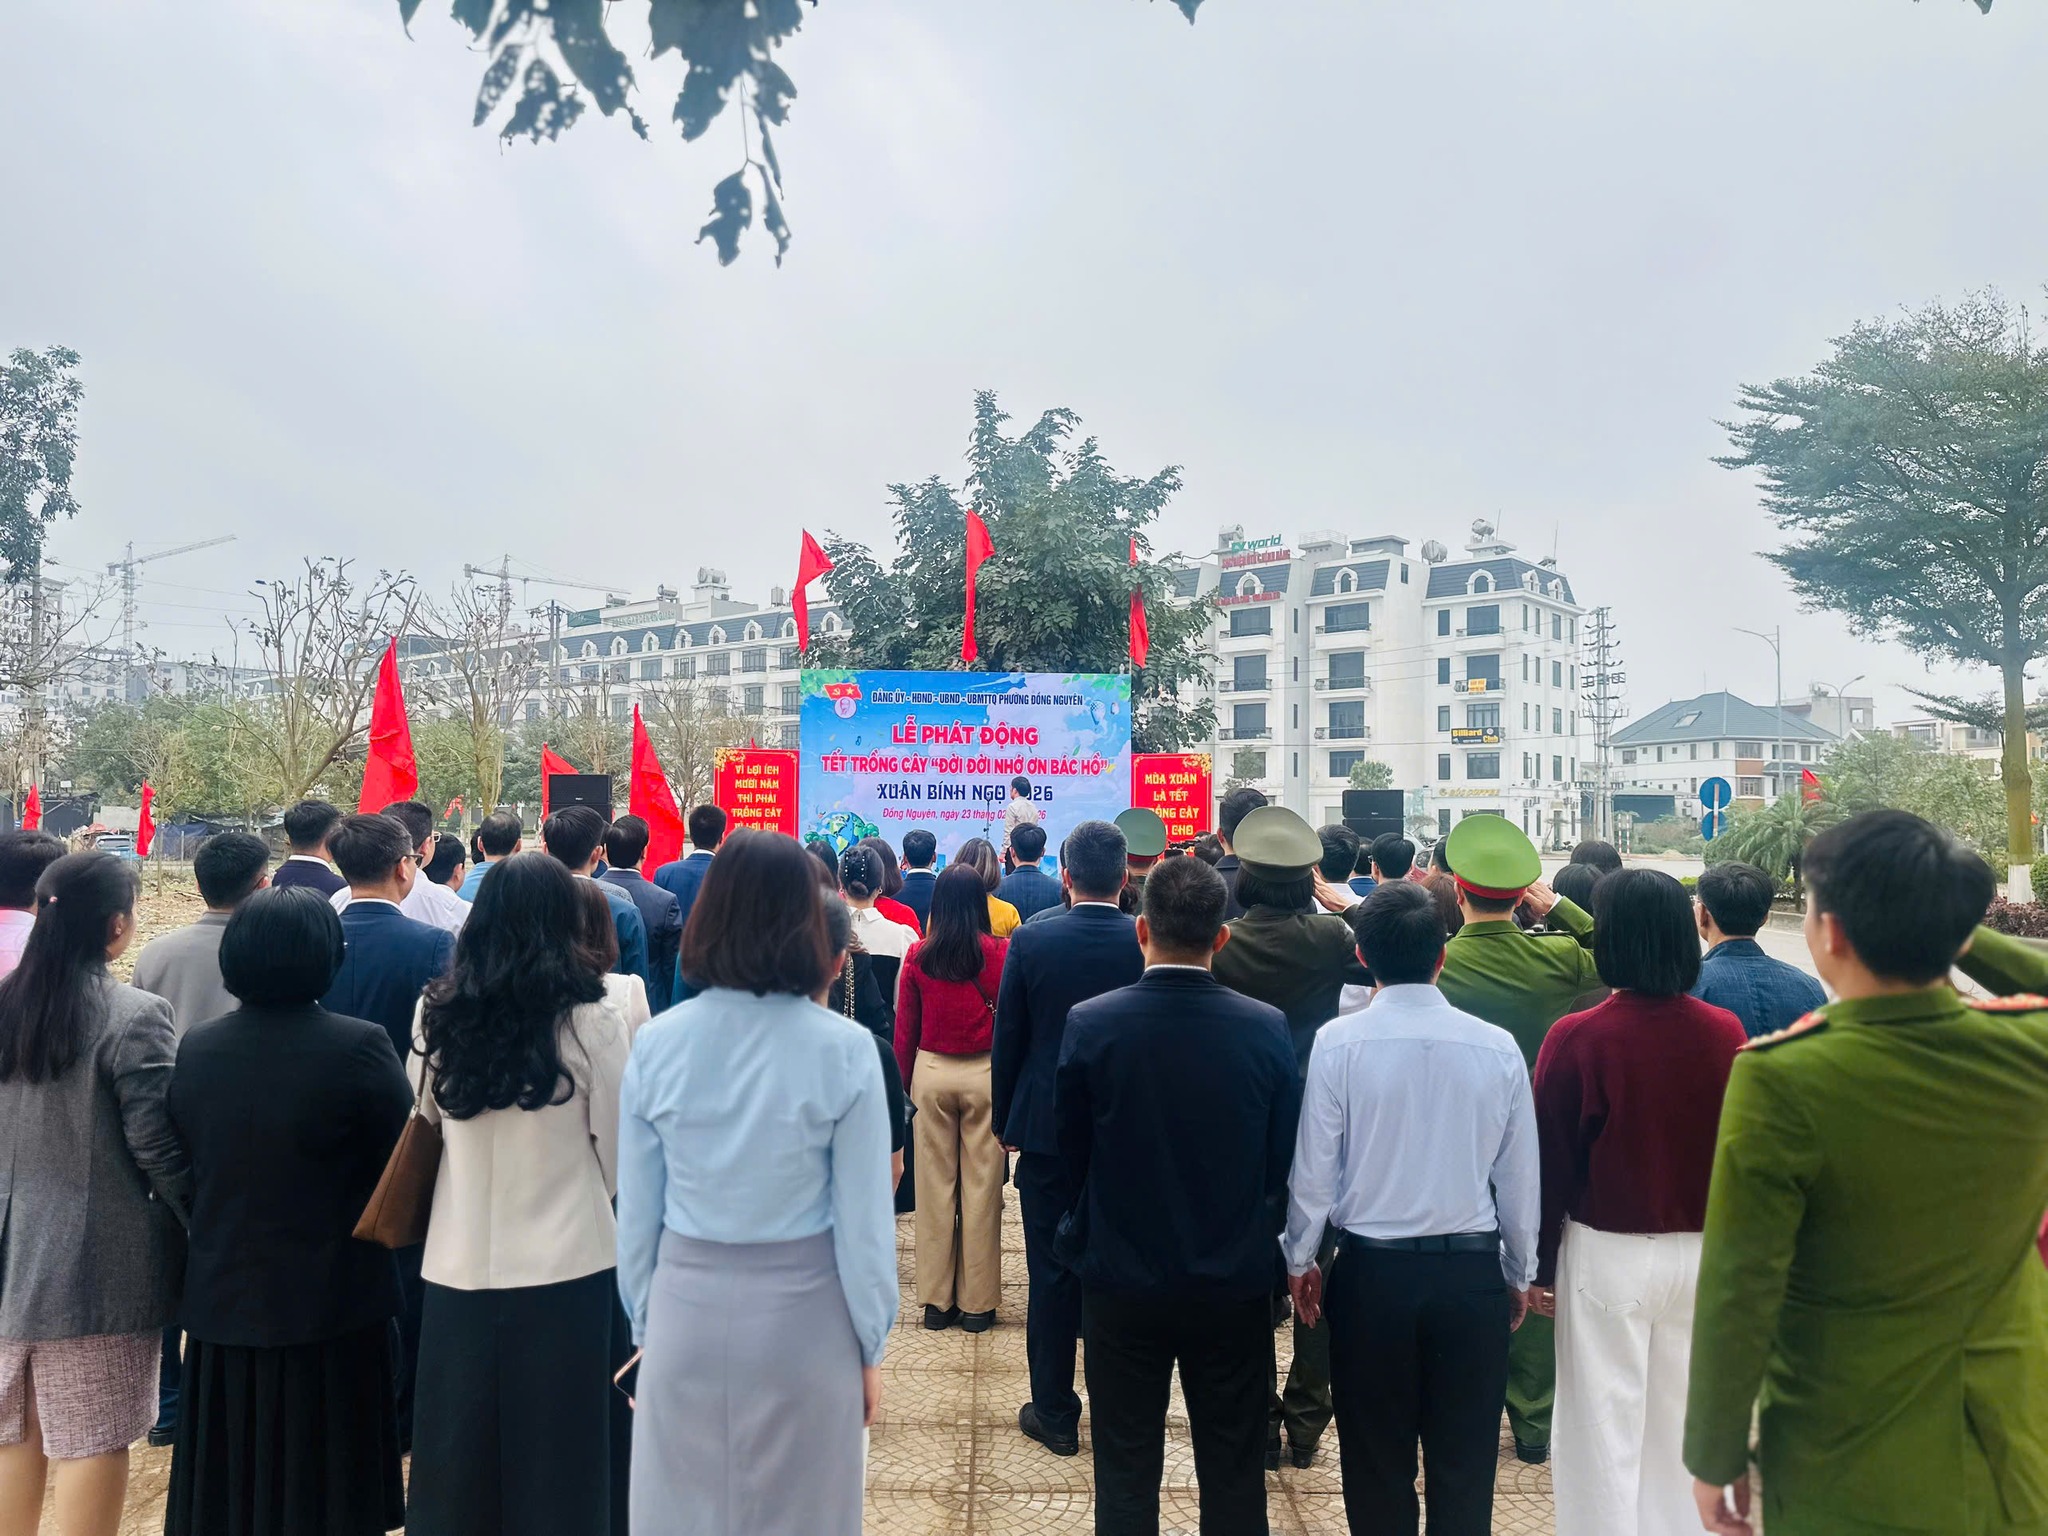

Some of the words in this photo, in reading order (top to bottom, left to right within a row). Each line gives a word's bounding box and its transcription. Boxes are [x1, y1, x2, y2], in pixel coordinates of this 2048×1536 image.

[1248, 534, 1281, 549] world
[872, 688, 893, 702] ĐẢNG
[895, 689, 905, 702] ỦY
[912, 693, 933, 703] HĐND
[940, 693, 960, 703] UBND
[967, 693, 997, 705] UBMTTQ
[999, 692, 1029, 705] PHƯỜNG
[1031, 691, 1051, 705] ĐỒNG
[1053, 693, 1083, 705] NGUYÊN
[892, 715, 917, 743] LỄ
[922, 721, 975, 744] PHÁT
[979, 721, 1039, 749] ĐỘNG
[1452, 729, 1482, 737] Billiard
[822, 749, 848, 772] TẾT
[851, 750, 898, 773] TRỒNG
[901, 753, 928, 773] CÂY
[931, 754, 963, 774] “ĐỜI
[966, 754, 991, 774] ĐỜI
[994, 754, 1024, 775] NHỚ
[1027, 758, 1047, 775] ƠN
[1051, 755, 1078, 775] BÁC
[735, 764, 744, 774] VÌ
[747, 765, 761, 776] LỢI
[764, 764, 779, 774] ÍCH
[735, 779, 757, 788] MƯỜI
[760, 779, 779, 788] NĂM
[1145, 772, 1166, 784] MÙA
[1169, 772, 1197, 784] XUÂN
[737, 792, 752, 803] THÌ
[755, 792, 776, 803] PHẢI
[877, 780, 921, 799] XUÂN
[927, 781, 966, 800] BÍNH
[972, 785, 1005, 804] NGỌ
[1027, 786, 1053, 801] 26
[1153, 788, 1166, 801] LÀ
[1170, 787, 1188, 801] TẾT
[731, 805, 762, 818] TRỒNG
[765, 807, 782, 817] CÂY
[882, 807, 904, 820] Đồng
[906, 809, 938, 820] Nguyên,
[940, 809, 959, 820] ngày
[961, 810, 972, 819] 23
[973, 809, 995, 821] tháng
[1150, 804, 1176, 818] ỒNG
[1179, 805, 1199, 818] CÂY
[1171, 825, 1193, 836] CHO
